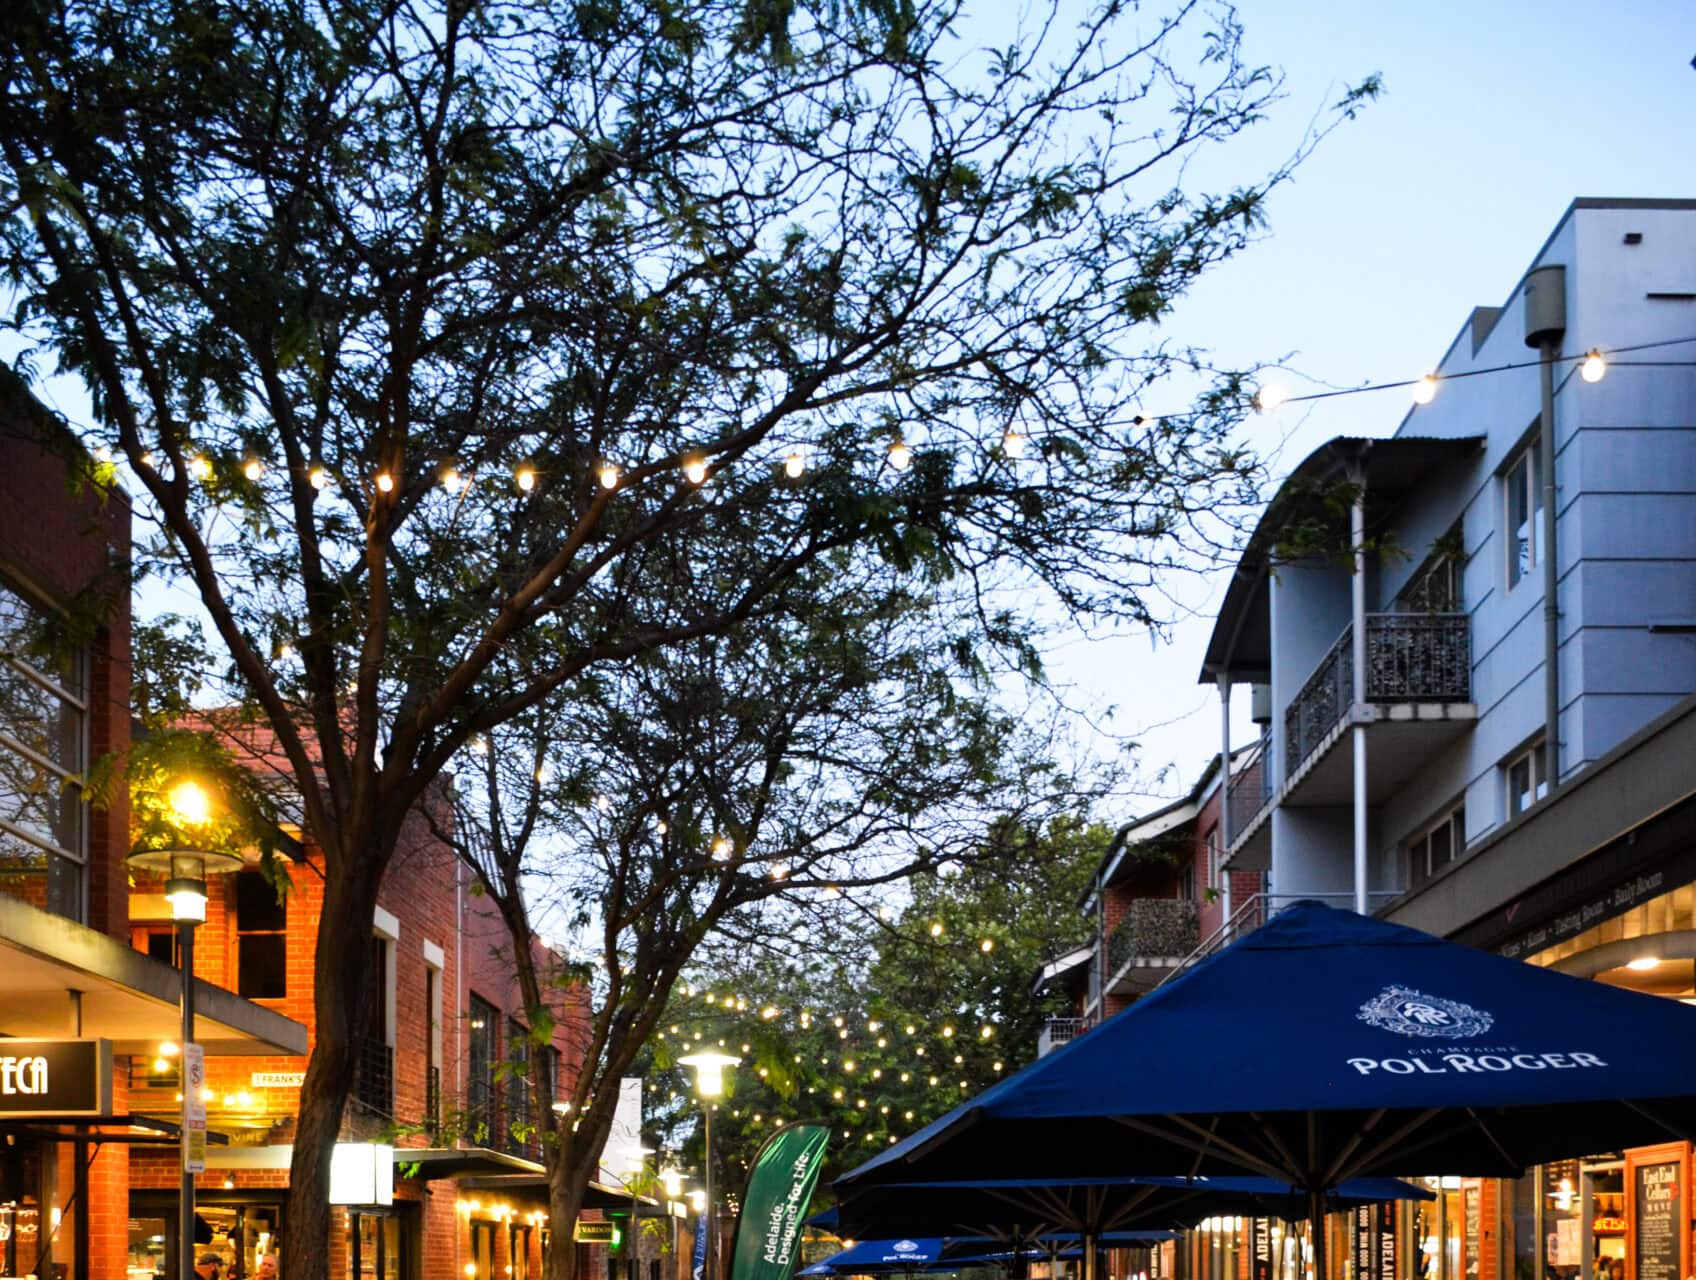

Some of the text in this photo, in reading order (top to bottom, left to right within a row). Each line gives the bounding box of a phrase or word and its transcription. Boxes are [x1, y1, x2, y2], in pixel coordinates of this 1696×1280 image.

[1347, 1052, 1609, 1076] POL ROGER
[1407, 1046, 1520, 1056] CHAMPAGNE
[0, 1056, 48, 1095] ECA
[763, 1202, 785, 1264] Adelaide.
[777, 1204, 799, 1265] Designed
[788, 1181, 802, 1202] for
